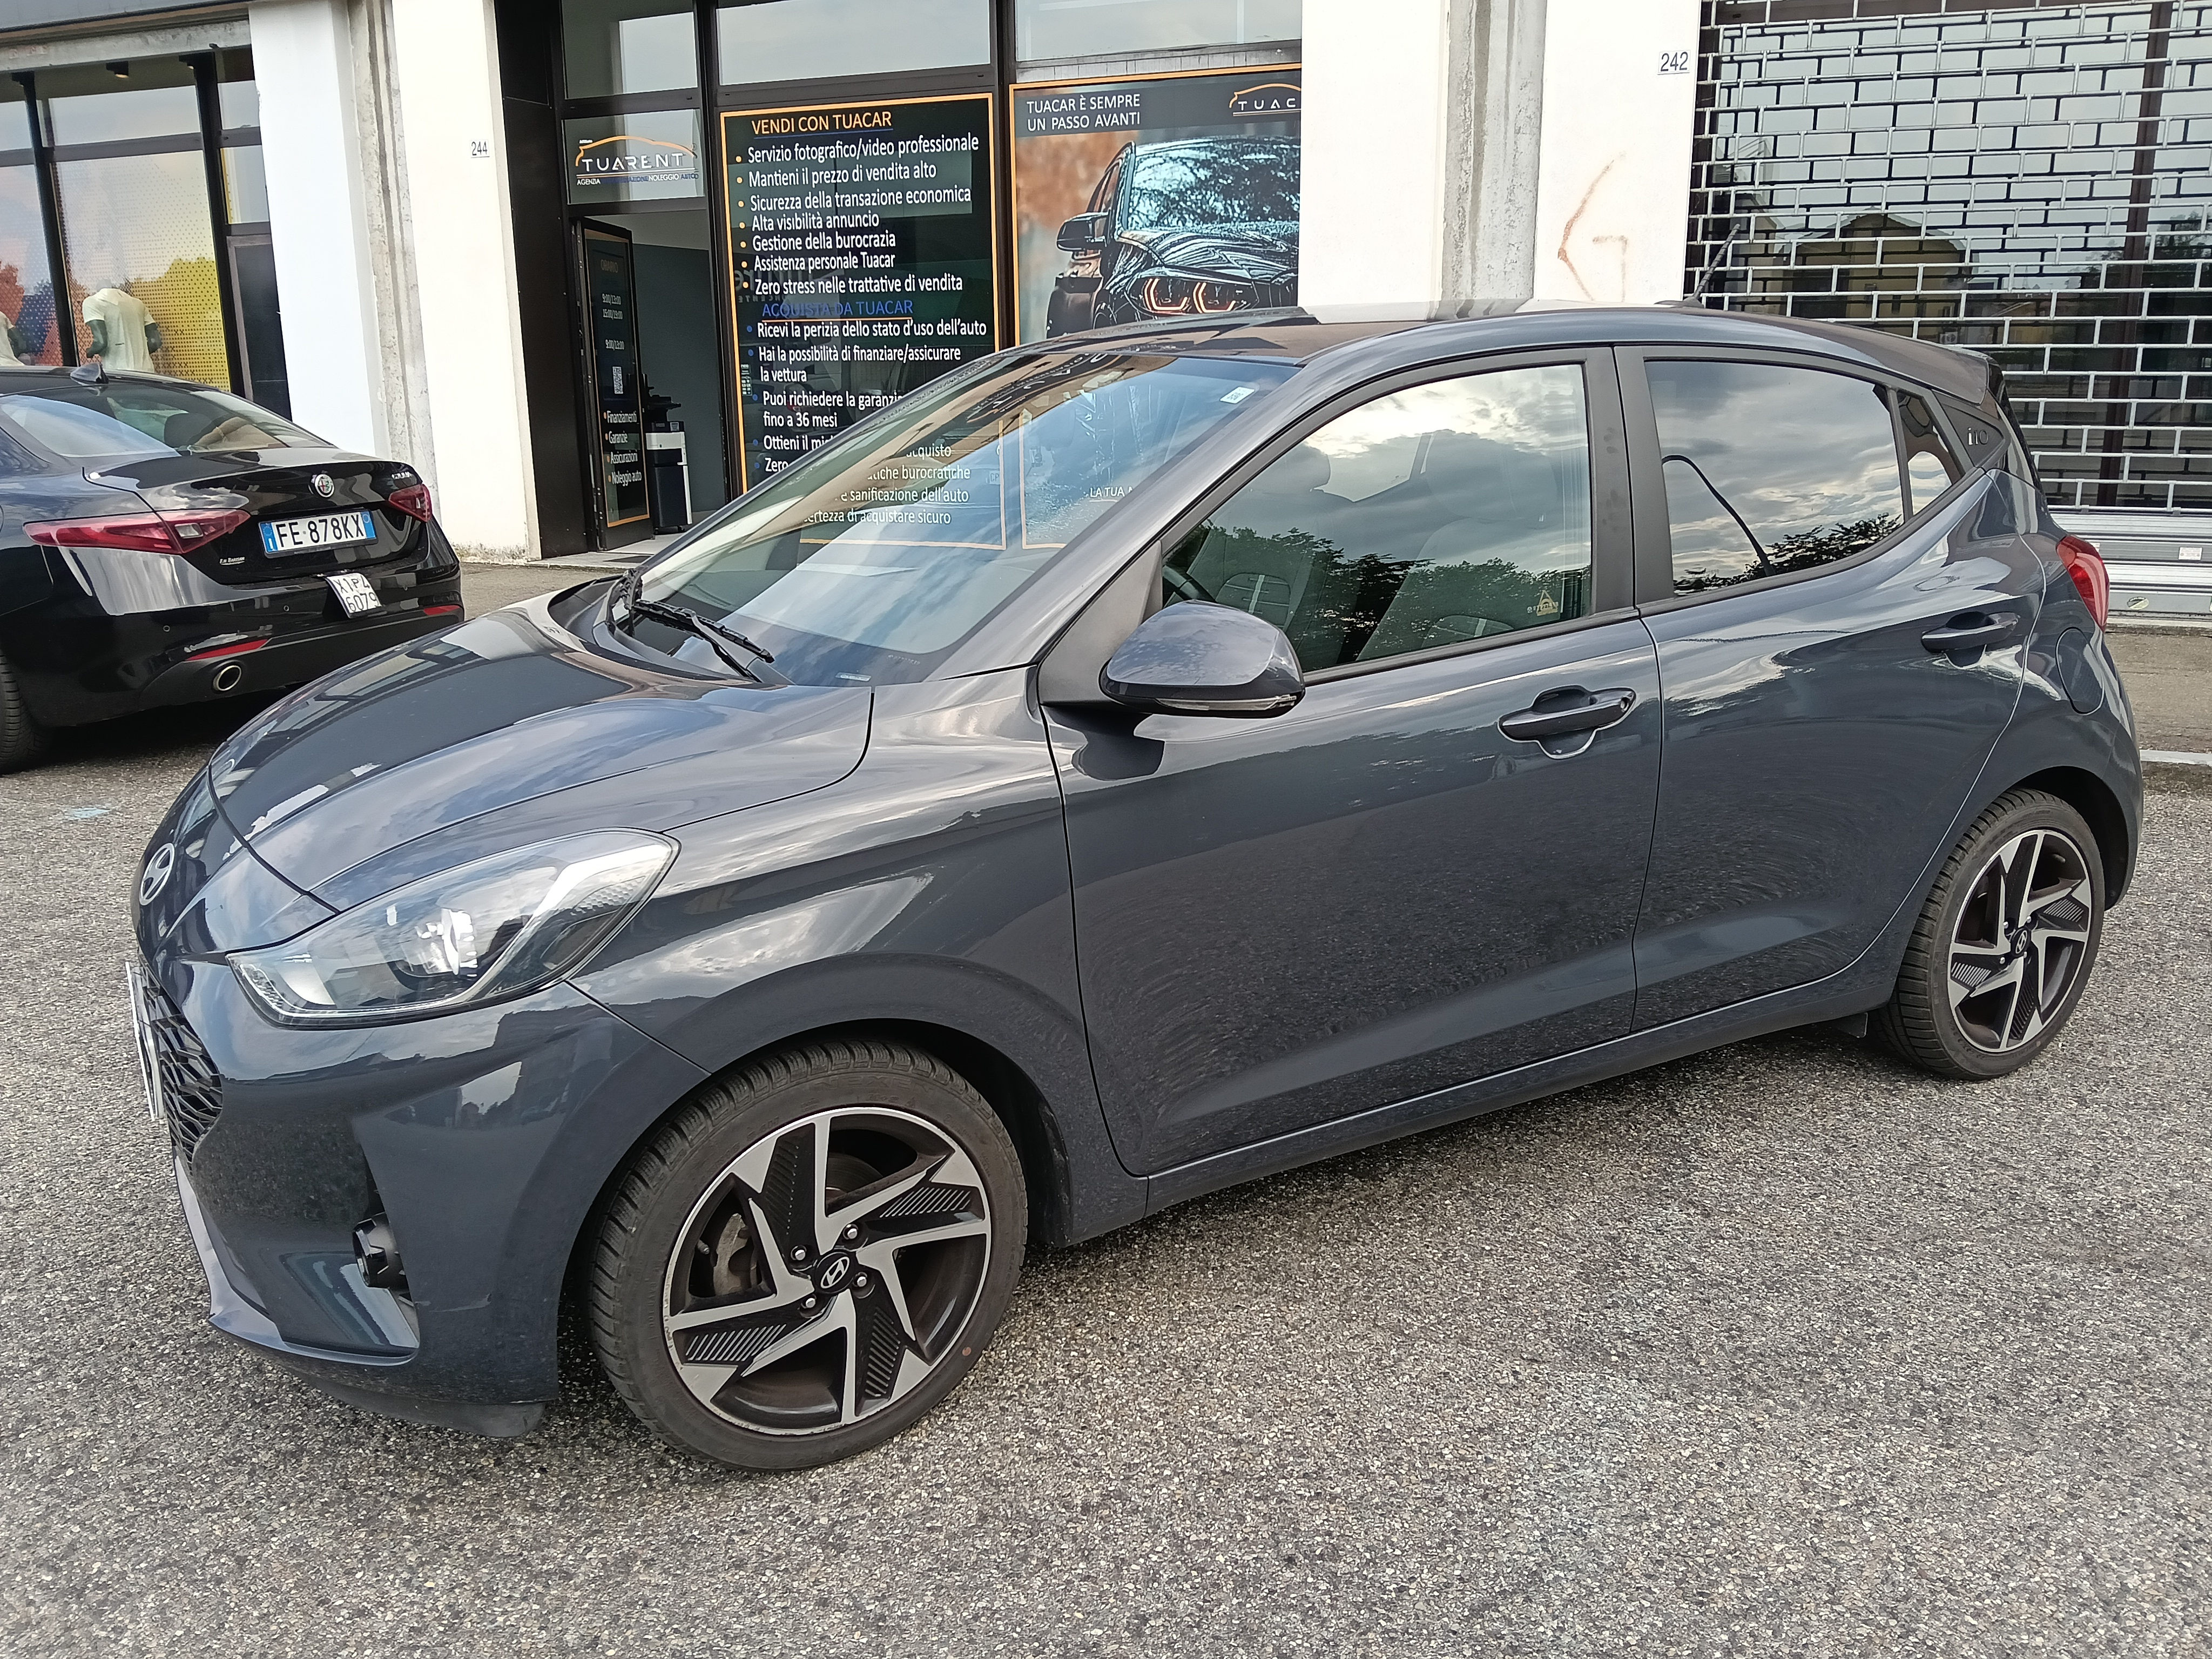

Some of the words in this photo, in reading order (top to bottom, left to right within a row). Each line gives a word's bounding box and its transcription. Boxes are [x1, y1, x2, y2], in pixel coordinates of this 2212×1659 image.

[1661, 51, 1688, 71] 242
[1027, 97, 1075, 113] TUACAR
[1080, 94, 1086, 111] È
[1090, 93, 1140, 109] SEMPRE
[1238, 98, 1296, 111] TUAC
[751, 118, 794, 135] VENDI
[798, 115, 829, 132] CON
[832, 111, 892, 130] TUACAR
[1028, 117, 1046, 131] UN
[1051, 114, 1090, 130] PASSO
[1095, 112, 1140, 127] AVANTI
[471, 140, 488, 156] 244
[748, 145, 791, 164] Servizio
[794, 138, 894, 163] fotografico/video
[898, 132, 979, 158] professionale
[582, 153, 683, 172] TUARENT
[649, 173, 679, 181] NOLEGGIO
[748, 168, 799, 187] Mantieni
[802, 167, 808, 185] il
[812, 170, 849, 188] prezzo
[852, 165, 863, 183] di
[866, 163, 909, 181] vendita
[913, 161, 936, 178] alto
[750, 193, 801, 211] Sicurezza
[805, 191, 832, 209] della
[835, 188, 902, 207] transazione
[906, 185, 971, 204] economica
[752, 215, 774, 232] Alta
[777, 212, 823, 230] visibilità
[826, 211, 879, 228] annuncio
[752, 235, 802, 252] Gestione
[805, 233, 832, 250] della
[835, 230, 896, 248] burocrazia
[754, 254, 806, 272] Assistenza
[808, 251, 858, 273] personale
[861, 252, 895, 268] Tuacar
[755, 279, 780, 295] Zero
[783, 279, 816, 295] stress
[818, 276, 845, 293] nelle
[848, 275, 901, 293] trattative
[904, 274, 916, 291] di
[918, 273, 963, 291] vendita
[762, 302, 831, 318] ACQUISTA
[836, 302, 853, 315] DA
[855, 300, 913, 314] TUACAR
[757, 322, 789, 338] Ricevi
[791, 322, 801, 337] la
[804, 322, 840, 340] perizia
[842, 320, 869, 337] dello
[872, 322, 901, 336] stato
[759, 346, 776, 361] Hai
[777, 346, 787, 361] la
[789, 345, 839, 365] possibilità
[841, 345, 851, 360] di
[853, 344, 961, 363] finanziare/assicurare
[760, 367, 770, 382] la
[771, 368, 807, 382] vettura
[763, 392, 787, 406] Puoi
[789, 392, 843, 406] richiedere
[846, 392, 856, 407] la
[607, 410, 637, 423] Finanziamenti
[763, 412, 785, 427] fino
[787, 415, 793, 427] a
[796, 413, 810, 427] 36
[812, 412, 837, 428] mesi
[609, 431, 628, 444] Garanzie
[764, 435, 799, 450] Ottieni
[802, 435, 808, 450] il
[1967, 427, 1988, 445] i10
[611, 450, 638, 464] Assicurazioni
[612, 470, 632, 486] Noleggio
[632, 471, 642, 481] auto
[902, 464, 970, 480] burocratiche
[850, 486, 918, 502] sanificazione
[1090, 487, 1102, 497] LA
[1104, 486, 1125, 497] TUA
[861, 509, 915, 525] acquistare
[918, 509, 951, 524] sicuro
[275, 522, 303, 547] FE
[307, 514, 364, 543] 878KX
[346, 592, 378, 611] 6079
